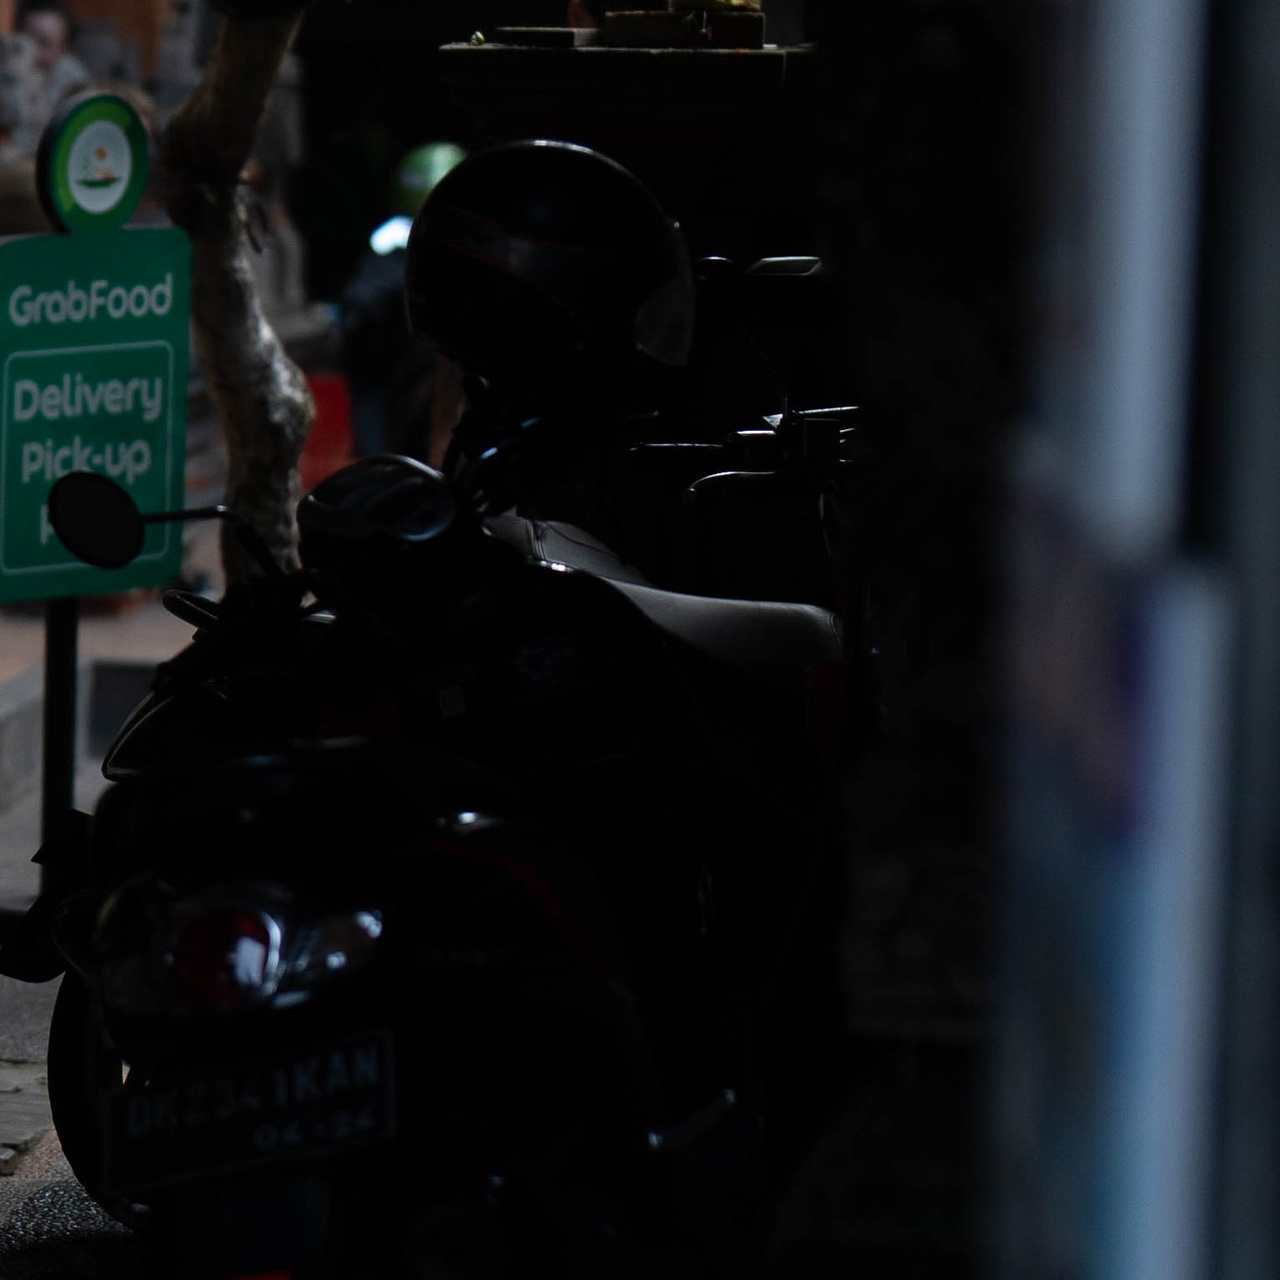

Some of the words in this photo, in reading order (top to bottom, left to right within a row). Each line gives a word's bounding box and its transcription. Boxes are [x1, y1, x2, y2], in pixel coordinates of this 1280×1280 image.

[9, 273, 175, 327] GrabFood
[12, 371, 164, 421] Delivery
[21, 434, 153, 485] Pick-up
